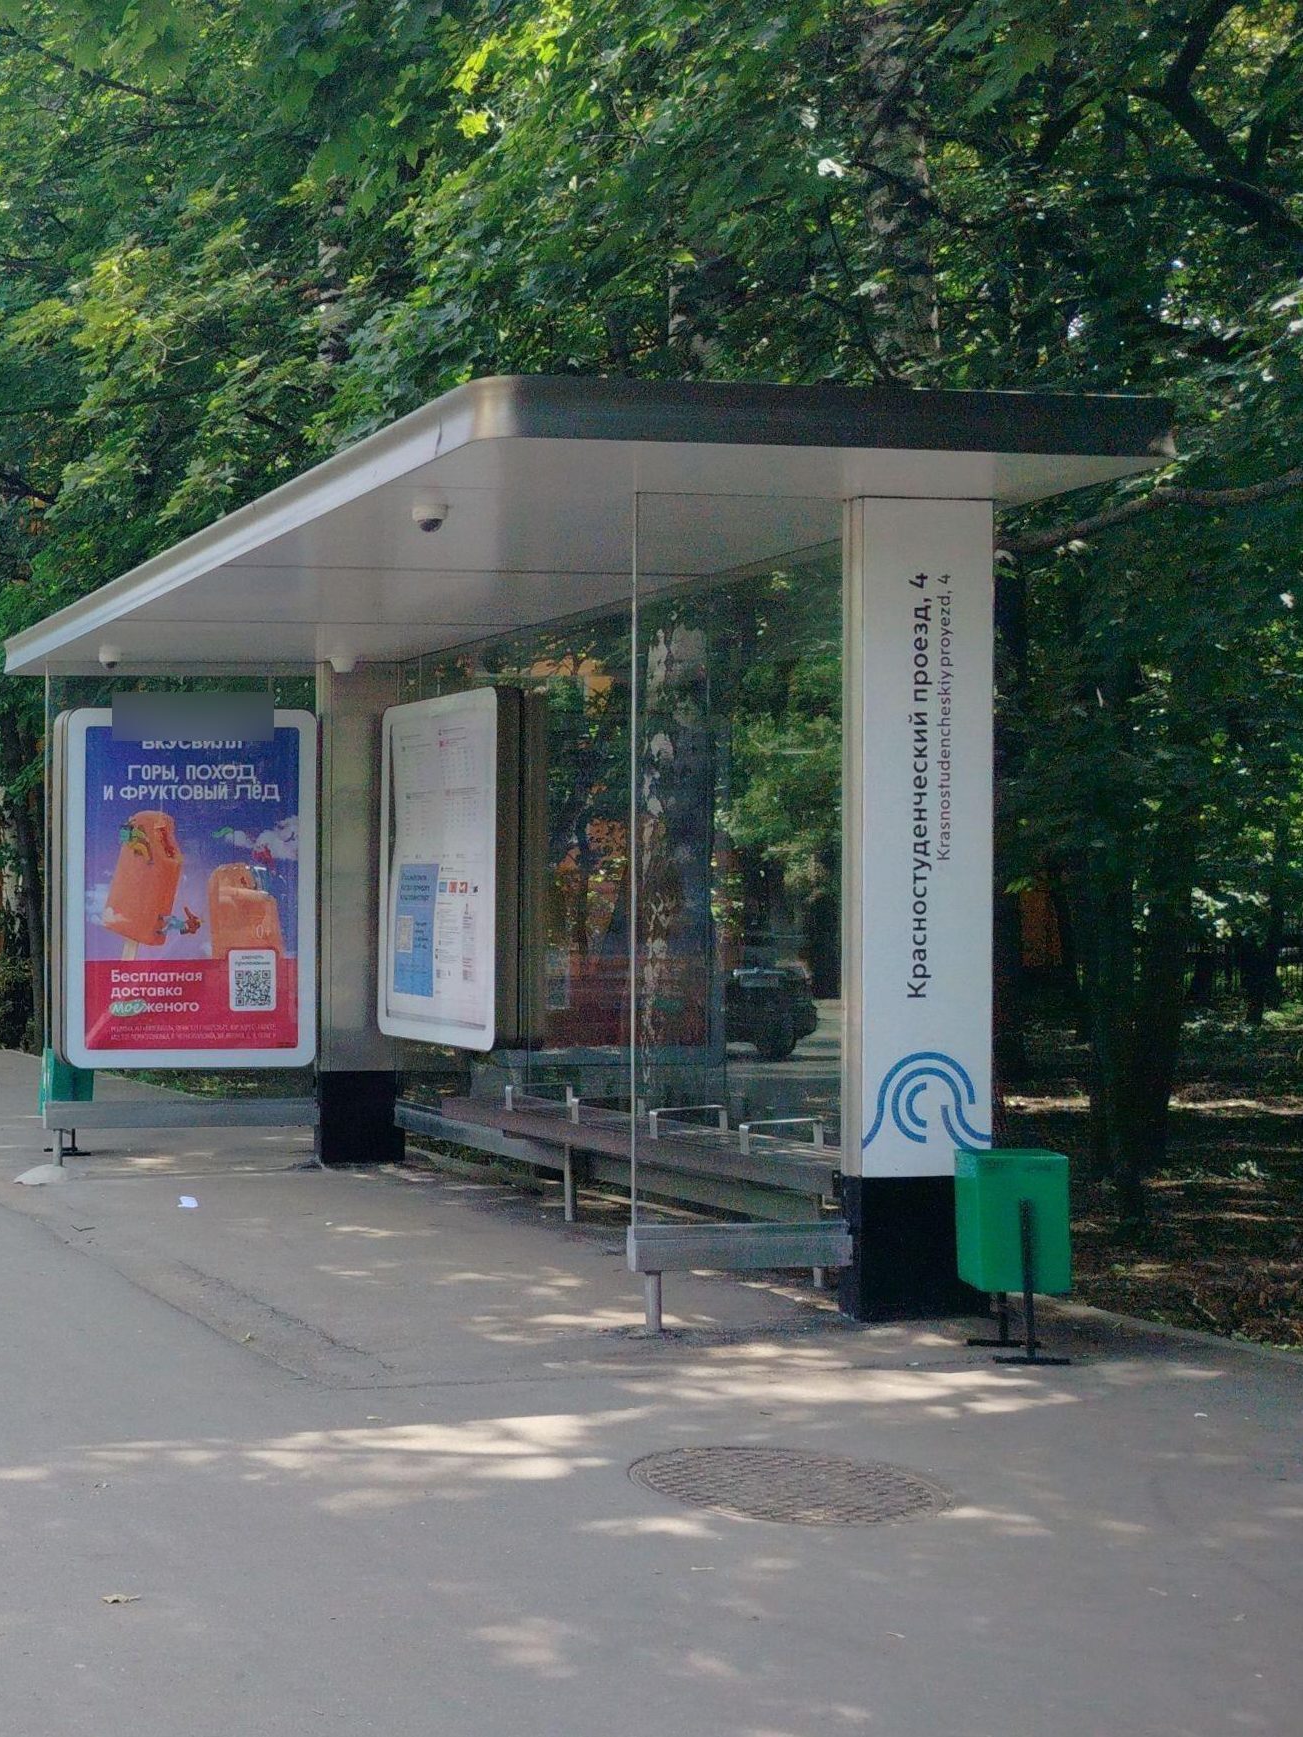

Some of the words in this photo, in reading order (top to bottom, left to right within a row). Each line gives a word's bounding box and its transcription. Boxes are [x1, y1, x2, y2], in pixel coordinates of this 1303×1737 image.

[908, 572, 929, 589] 4
[937, 573, 951, 585] 4
[936, 590, 954, 667] proyezd,
[912, 598, 933, 702] проезд,
[127, 764, 180, 783] ГОРЫ,
[185, 764, 257, 784] ПОХОД
[936, 669, 954, 861] Krasnostudencheskiy
[103, 785, 114, 801] И
[119, 781, 229, 801] ФРУКТОВЫЙ
[906, 712, 932, 998] Красностуденческий
[110, 969, 203, 983] Бесплатная
[110, 986, 183, 999] доставка
